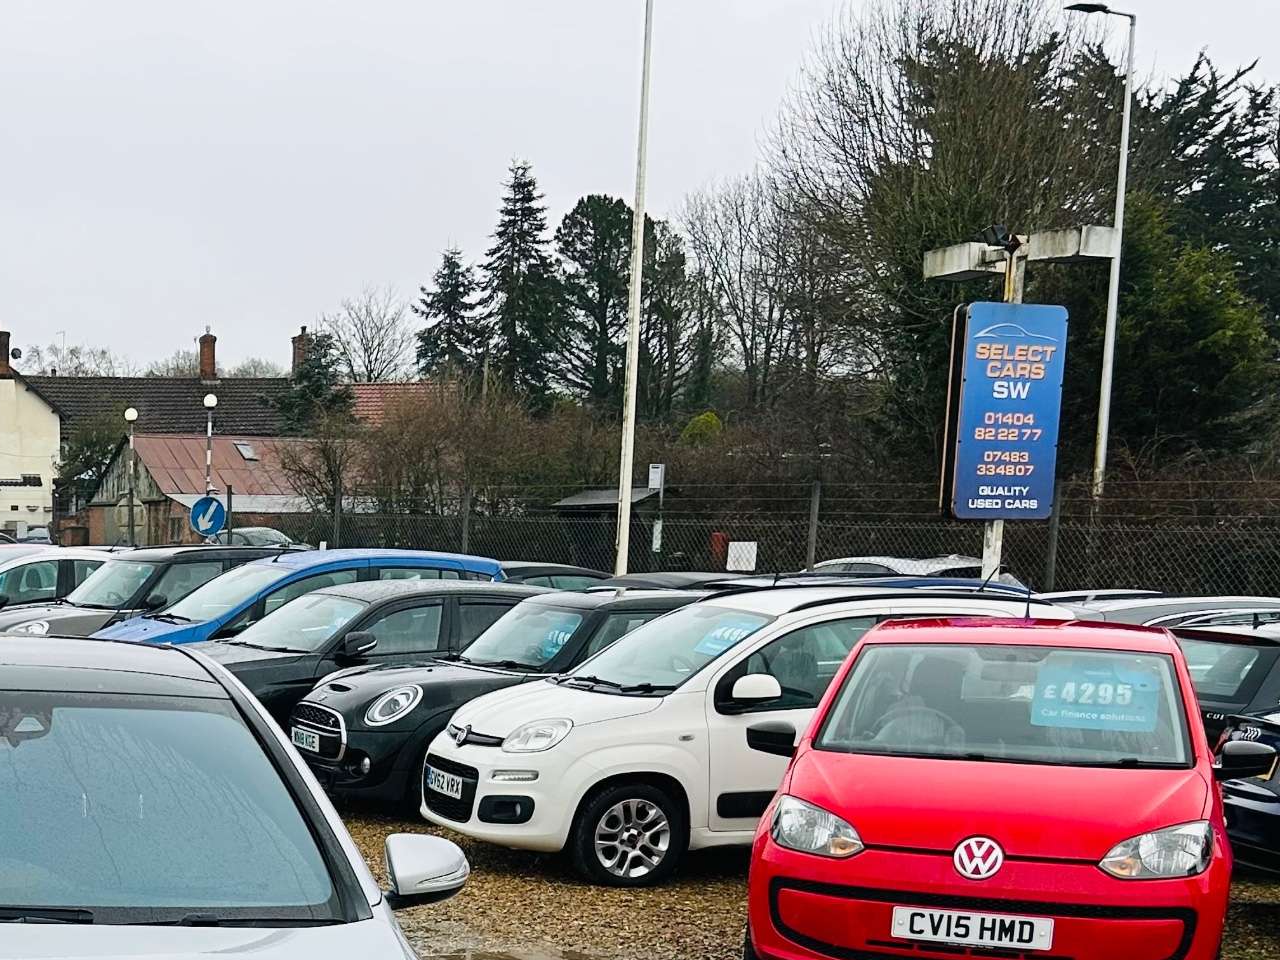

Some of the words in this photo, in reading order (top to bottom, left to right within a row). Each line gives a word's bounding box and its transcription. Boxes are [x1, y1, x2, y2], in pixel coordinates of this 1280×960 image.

[975, 343, 1056, 362] SELECT
[986, 361, 1045, 380] CARS
[992, 381, 1031, 400] SW
[984, 412, 1034, 426] 01404
[983, 451, 1029, 463] 07483
[976, 464, 1034, 476] 334807
[978, 485, 1030, 496] QUALITY
[968, 499, 1001, 509] USED
[1005, 499, 1038, 509] CARS
[1041, 708, 1058, 717] Car
[1060, 709, 1098, 720] finance
[446, 775, 461, 796] VRX
[908, 911, 971, 939] CV15
[978, 917, 1035, 944] HMD
